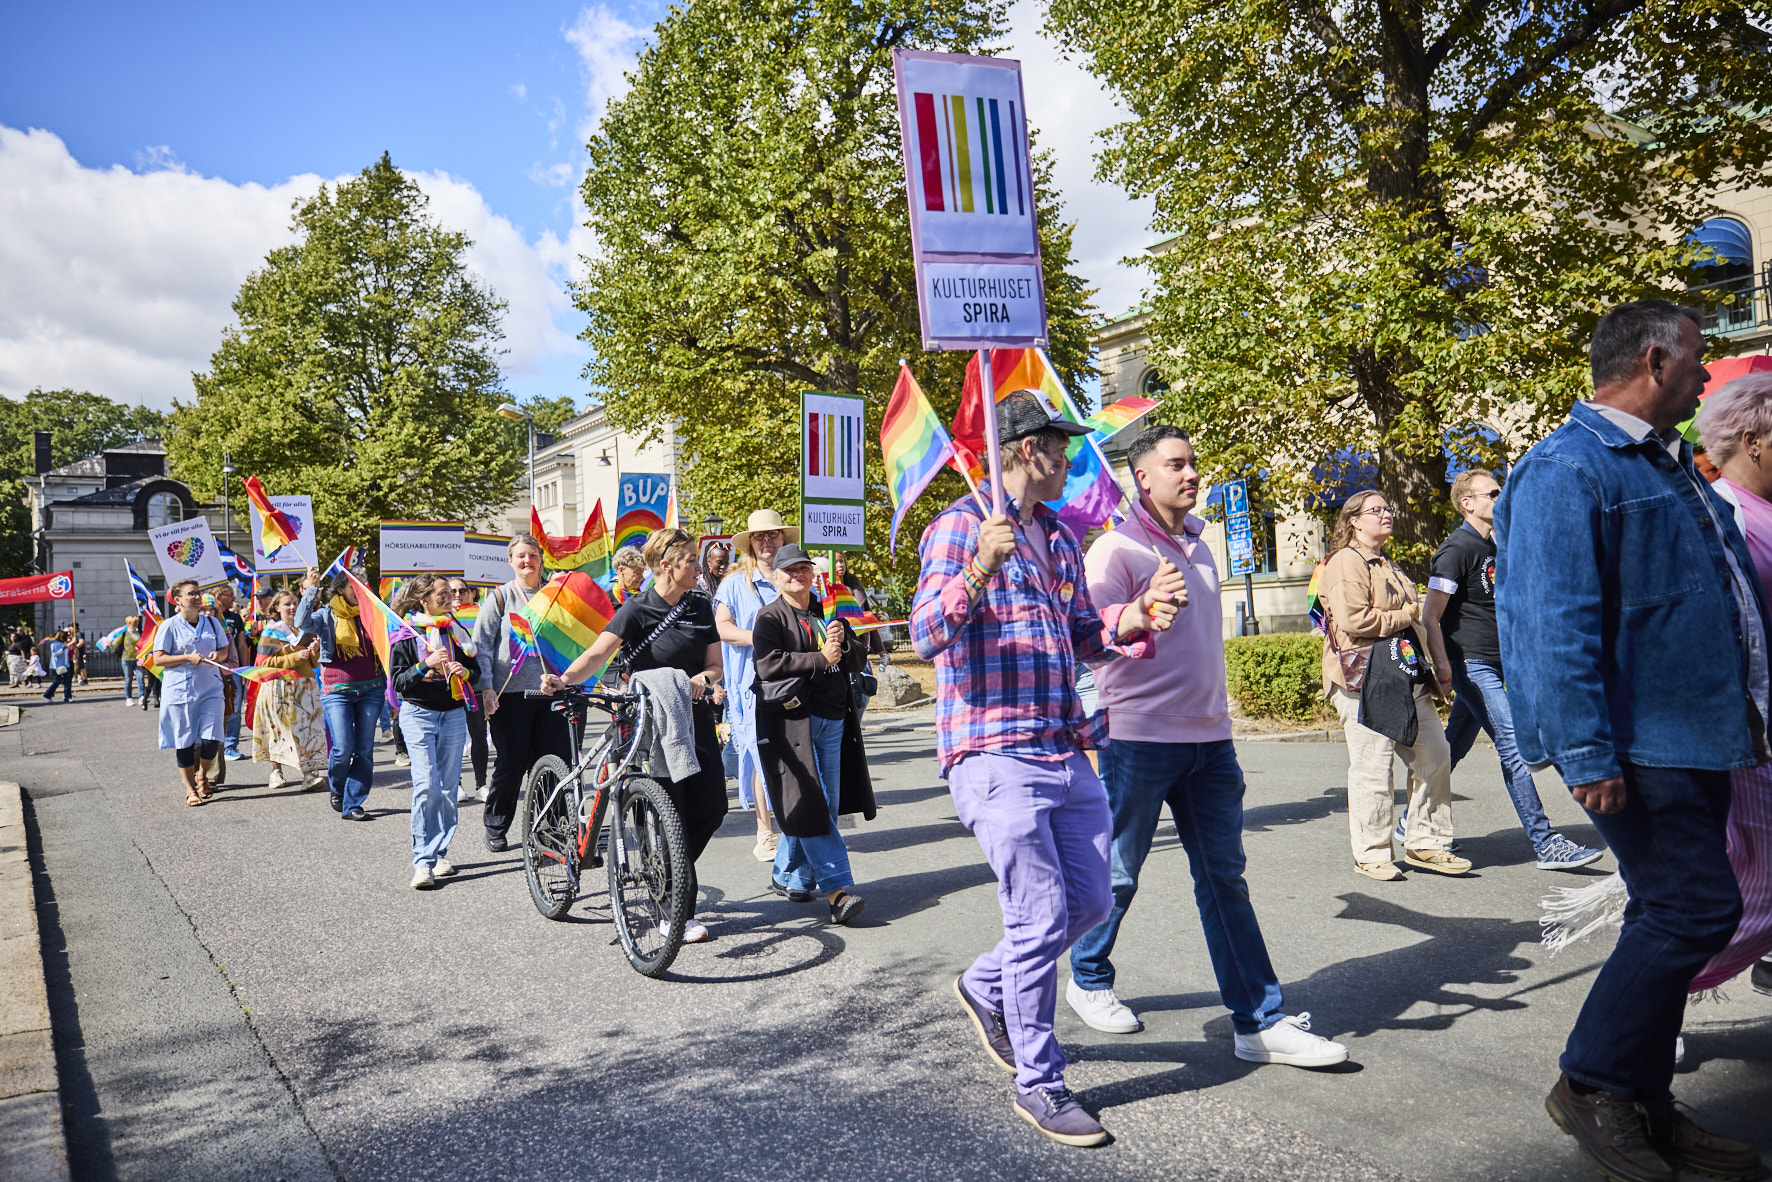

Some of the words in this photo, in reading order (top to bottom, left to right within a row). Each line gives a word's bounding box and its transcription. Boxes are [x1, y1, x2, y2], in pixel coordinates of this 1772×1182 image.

[932, 277, 1032, 299] KULTURHUSET
[963, 302, 1010, 323] SPIRA
[623, 478, 668, 506] BUP
[1229, 484, 1243, 511] P
[808, 512, 861, 524] KULTURHUSET
[822, 525, 848, 537] SPIRA
